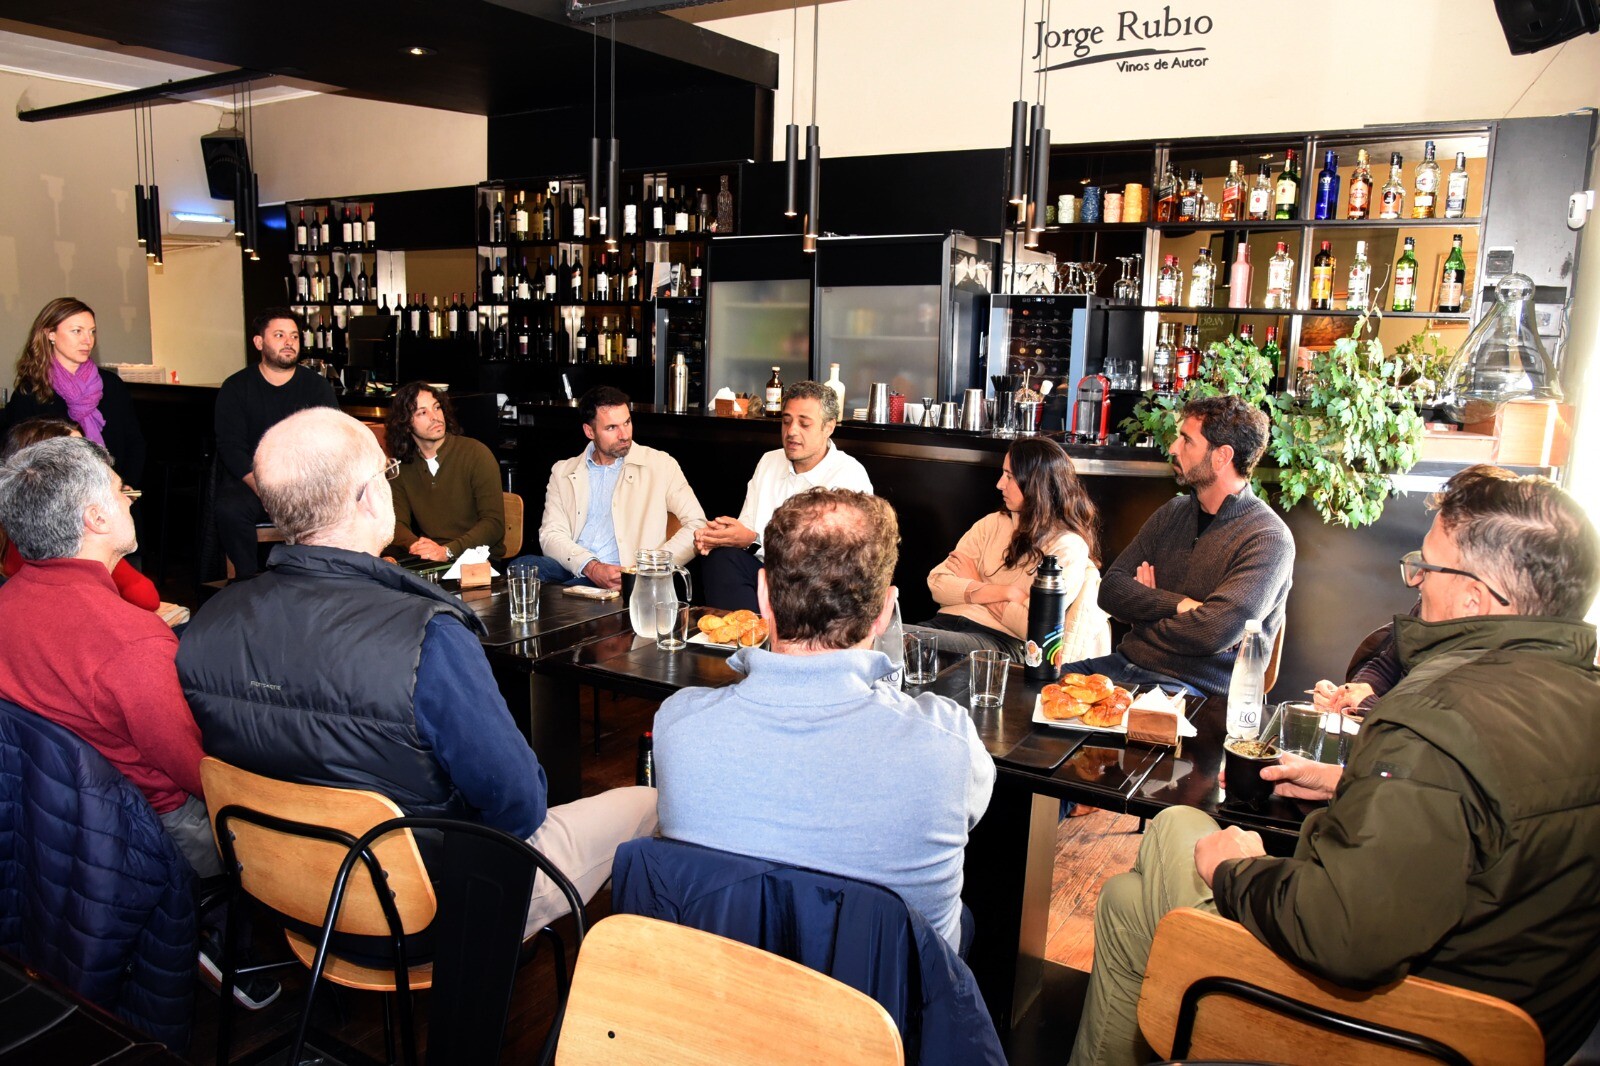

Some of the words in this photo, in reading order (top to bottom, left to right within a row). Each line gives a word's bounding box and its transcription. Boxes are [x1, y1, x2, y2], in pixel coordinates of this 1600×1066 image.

[1032, 20, 1105, 59] Jorge
[1116, 5, 1213, 41] Rubio
[1116, 61, 1150, 73] Vinos
[1153, 58, 1169, 70] de
[1171, 57, 1209, 69] Autor
